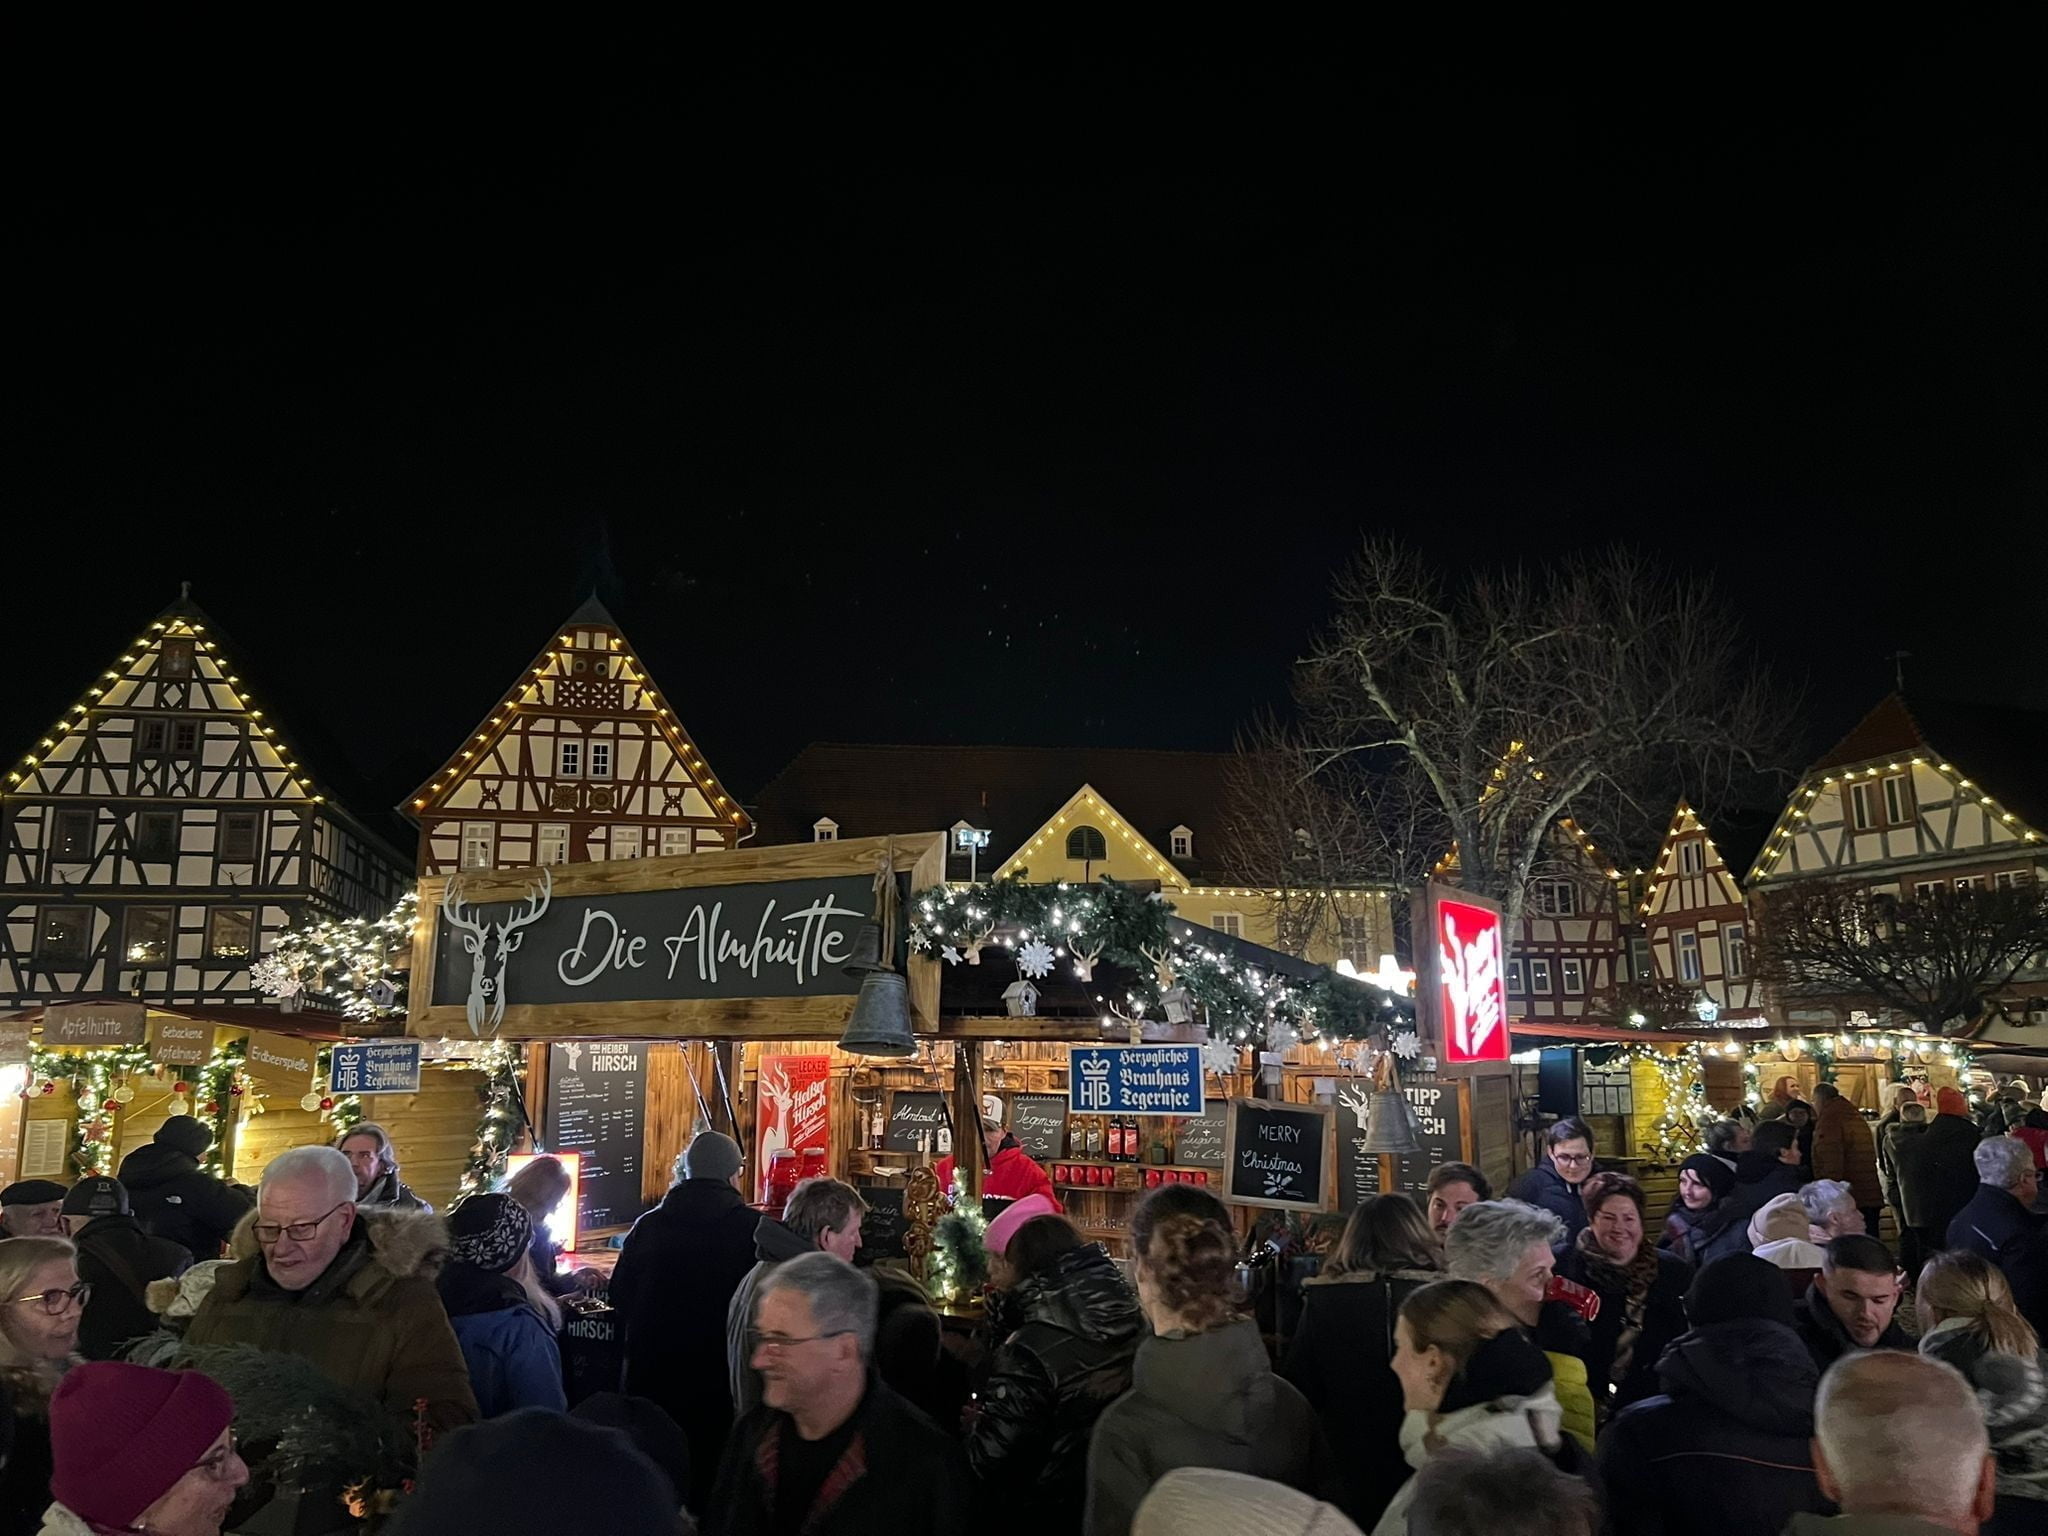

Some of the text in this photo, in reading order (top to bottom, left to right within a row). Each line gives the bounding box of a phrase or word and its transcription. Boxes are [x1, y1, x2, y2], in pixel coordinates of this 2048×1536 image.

[558, 894, 865, 986] Die Almhütte
[60, 1016, 122, 1038] Apfelhütte
[161, 1025, 204, 1040] Gebackene
[156, 1046, 202, 1064] Apfelringe
[251, 1046, 309, 1073] Erdbeerspieße
[365, 1046, 413, 1060] Herzogliches
[592, 1054, 638, 1072] HIRSCH
[1119, 1049, 1189, 1067] Herzogliches
[364, 1059, 412, 1075] Brauhaus
[799, 1060, 827, 1073] LECKER
[1119, 1068, 1190, 1090] Brauhaus
[1119, 1088, 1190, 1111] Tegernsee
[1258, 1124, 1301, 1144] MERRY
[1242, 1150, 1302, 1174] Christmas
[567, 1319, 615, 1341] HIRSCH
